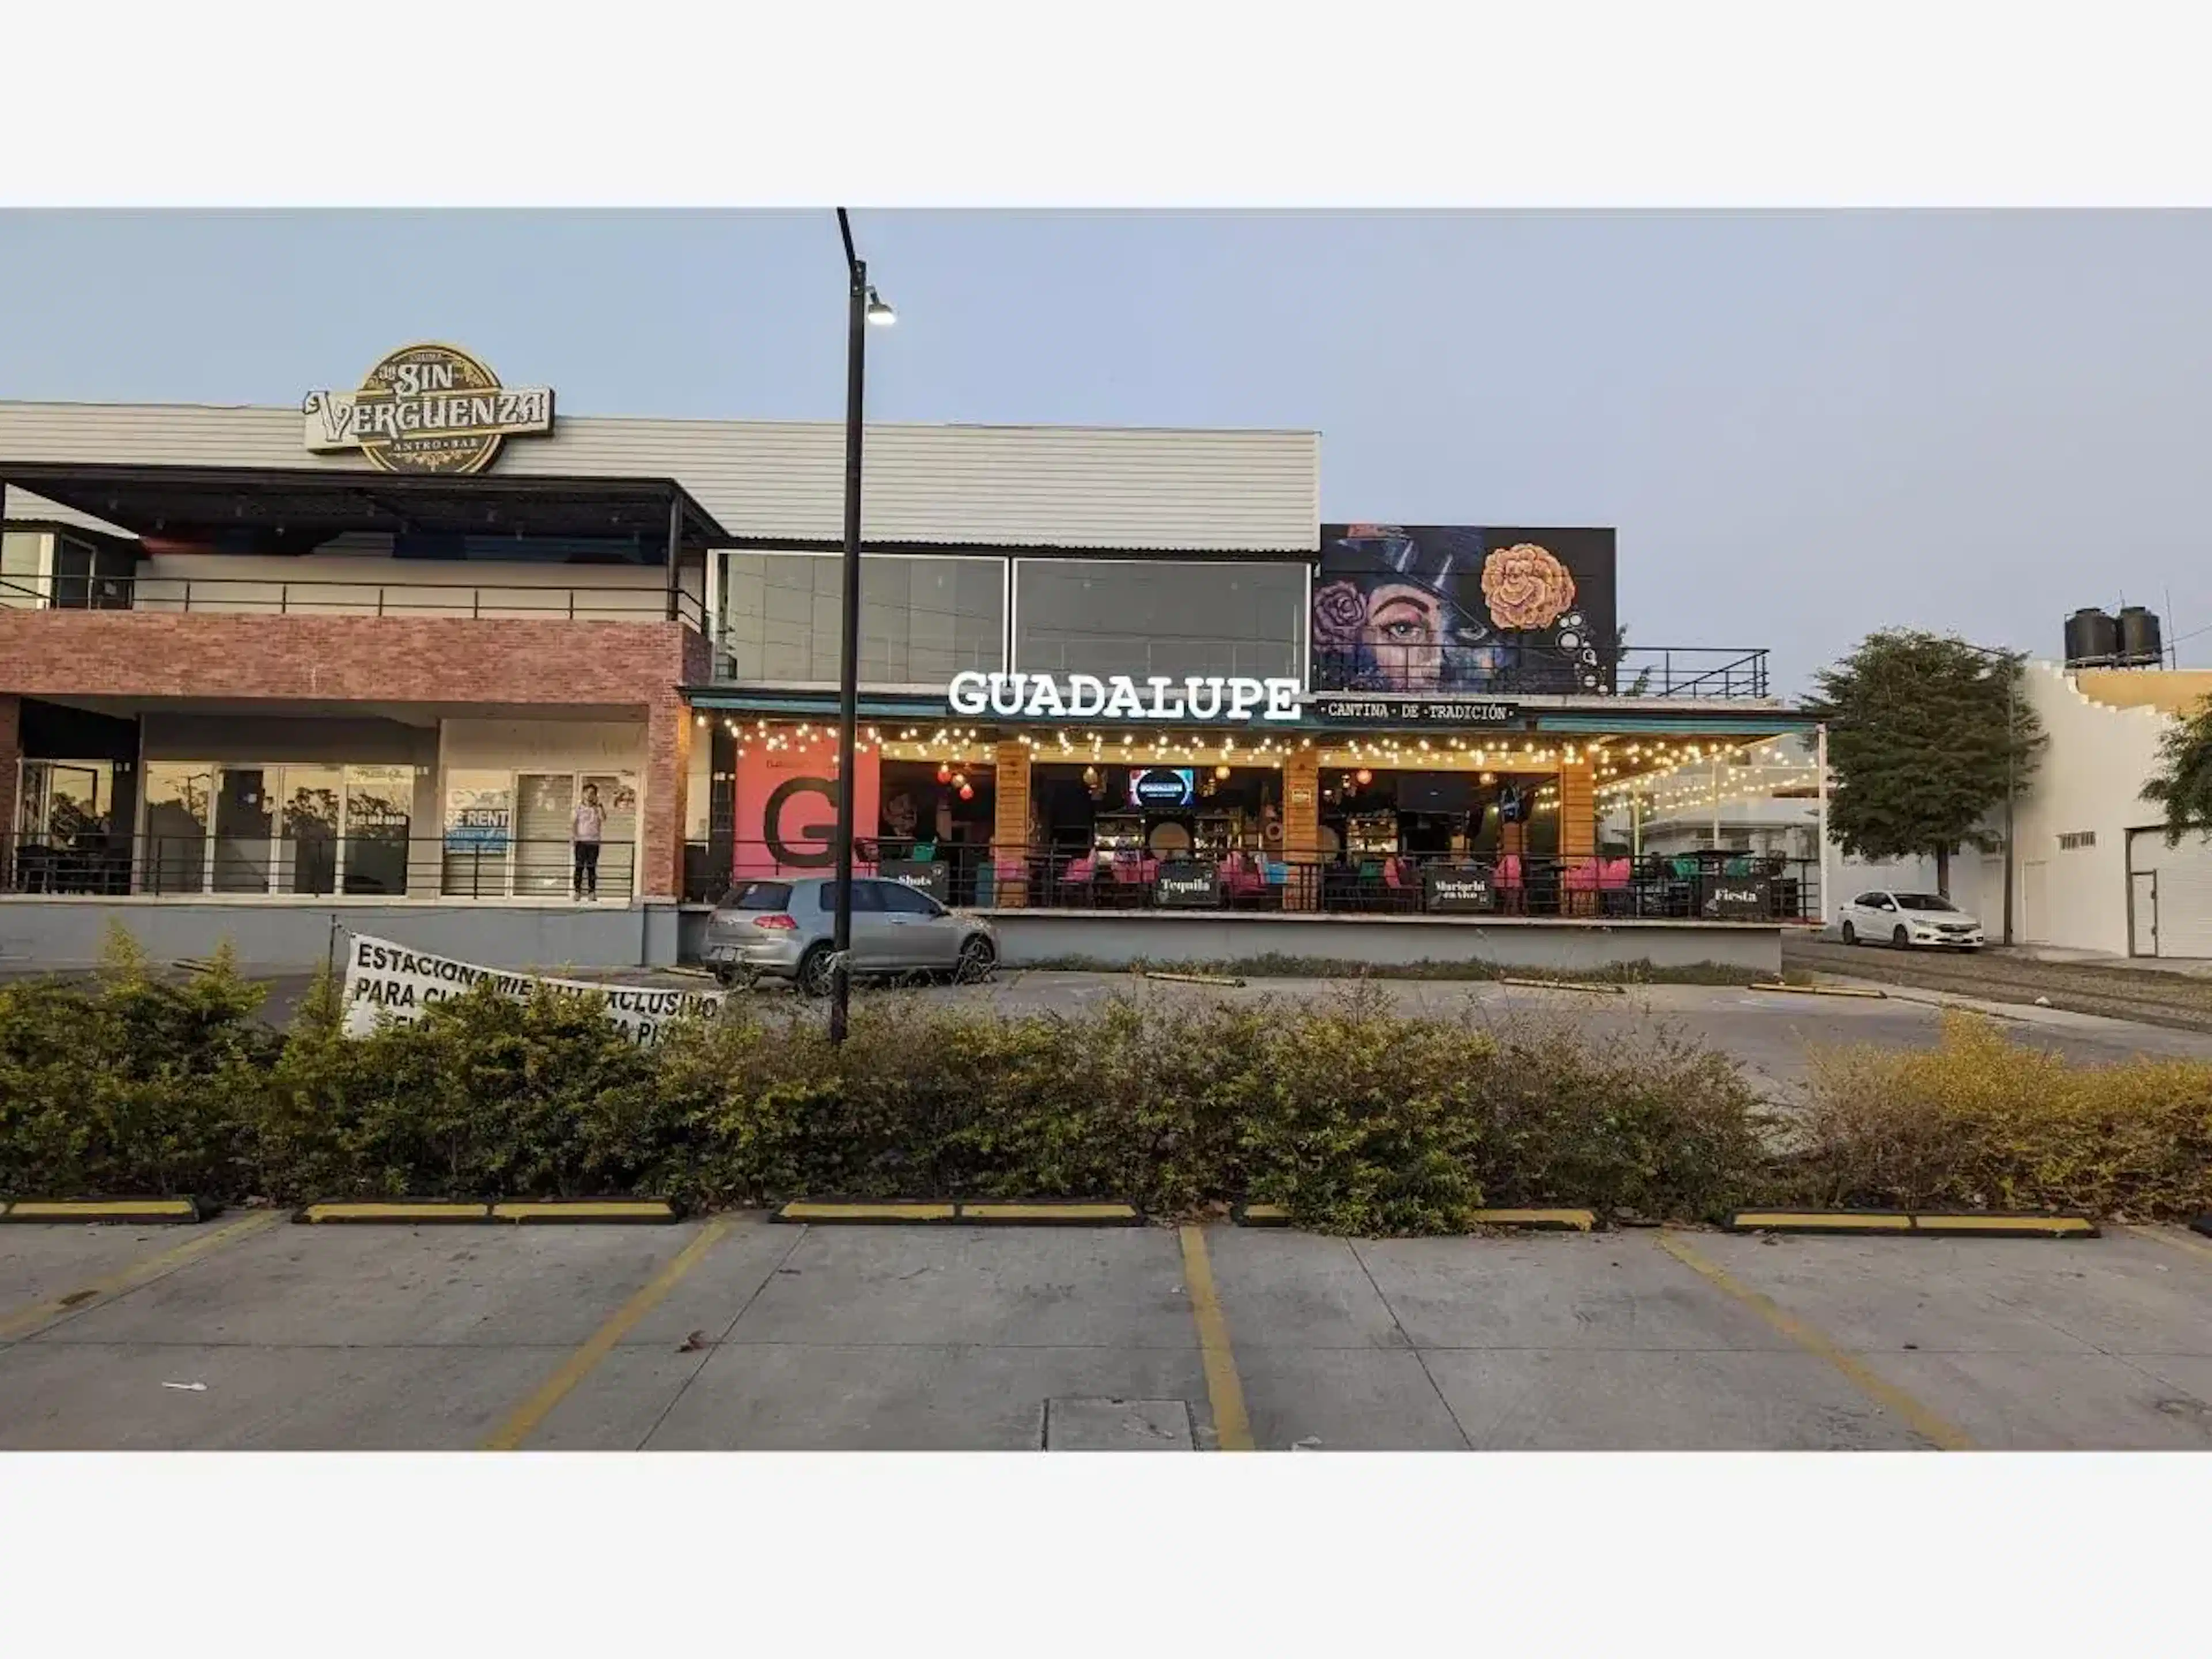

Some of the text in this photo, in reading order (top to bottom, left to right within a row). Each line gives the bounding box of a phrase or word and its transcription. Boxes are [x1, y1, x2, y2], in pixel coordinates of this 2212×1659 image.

[393, 363, 453, 397] SIN
[304, 391, 544, 442] VERGÜENZA
[949, 671, 1303, 720] GUADALUPE
[1328, 703, 1508, 720] CANTINA DE TRADICIÓN
[444, 810, 464, 826] SE
[1160, 878, 1210, 893] Tequila
[1715, 888, 1758, 903] Fiesta
[357, 943, 584, 997] ESTACIONAMIE
[355, 983, 415, 1007] PARA
